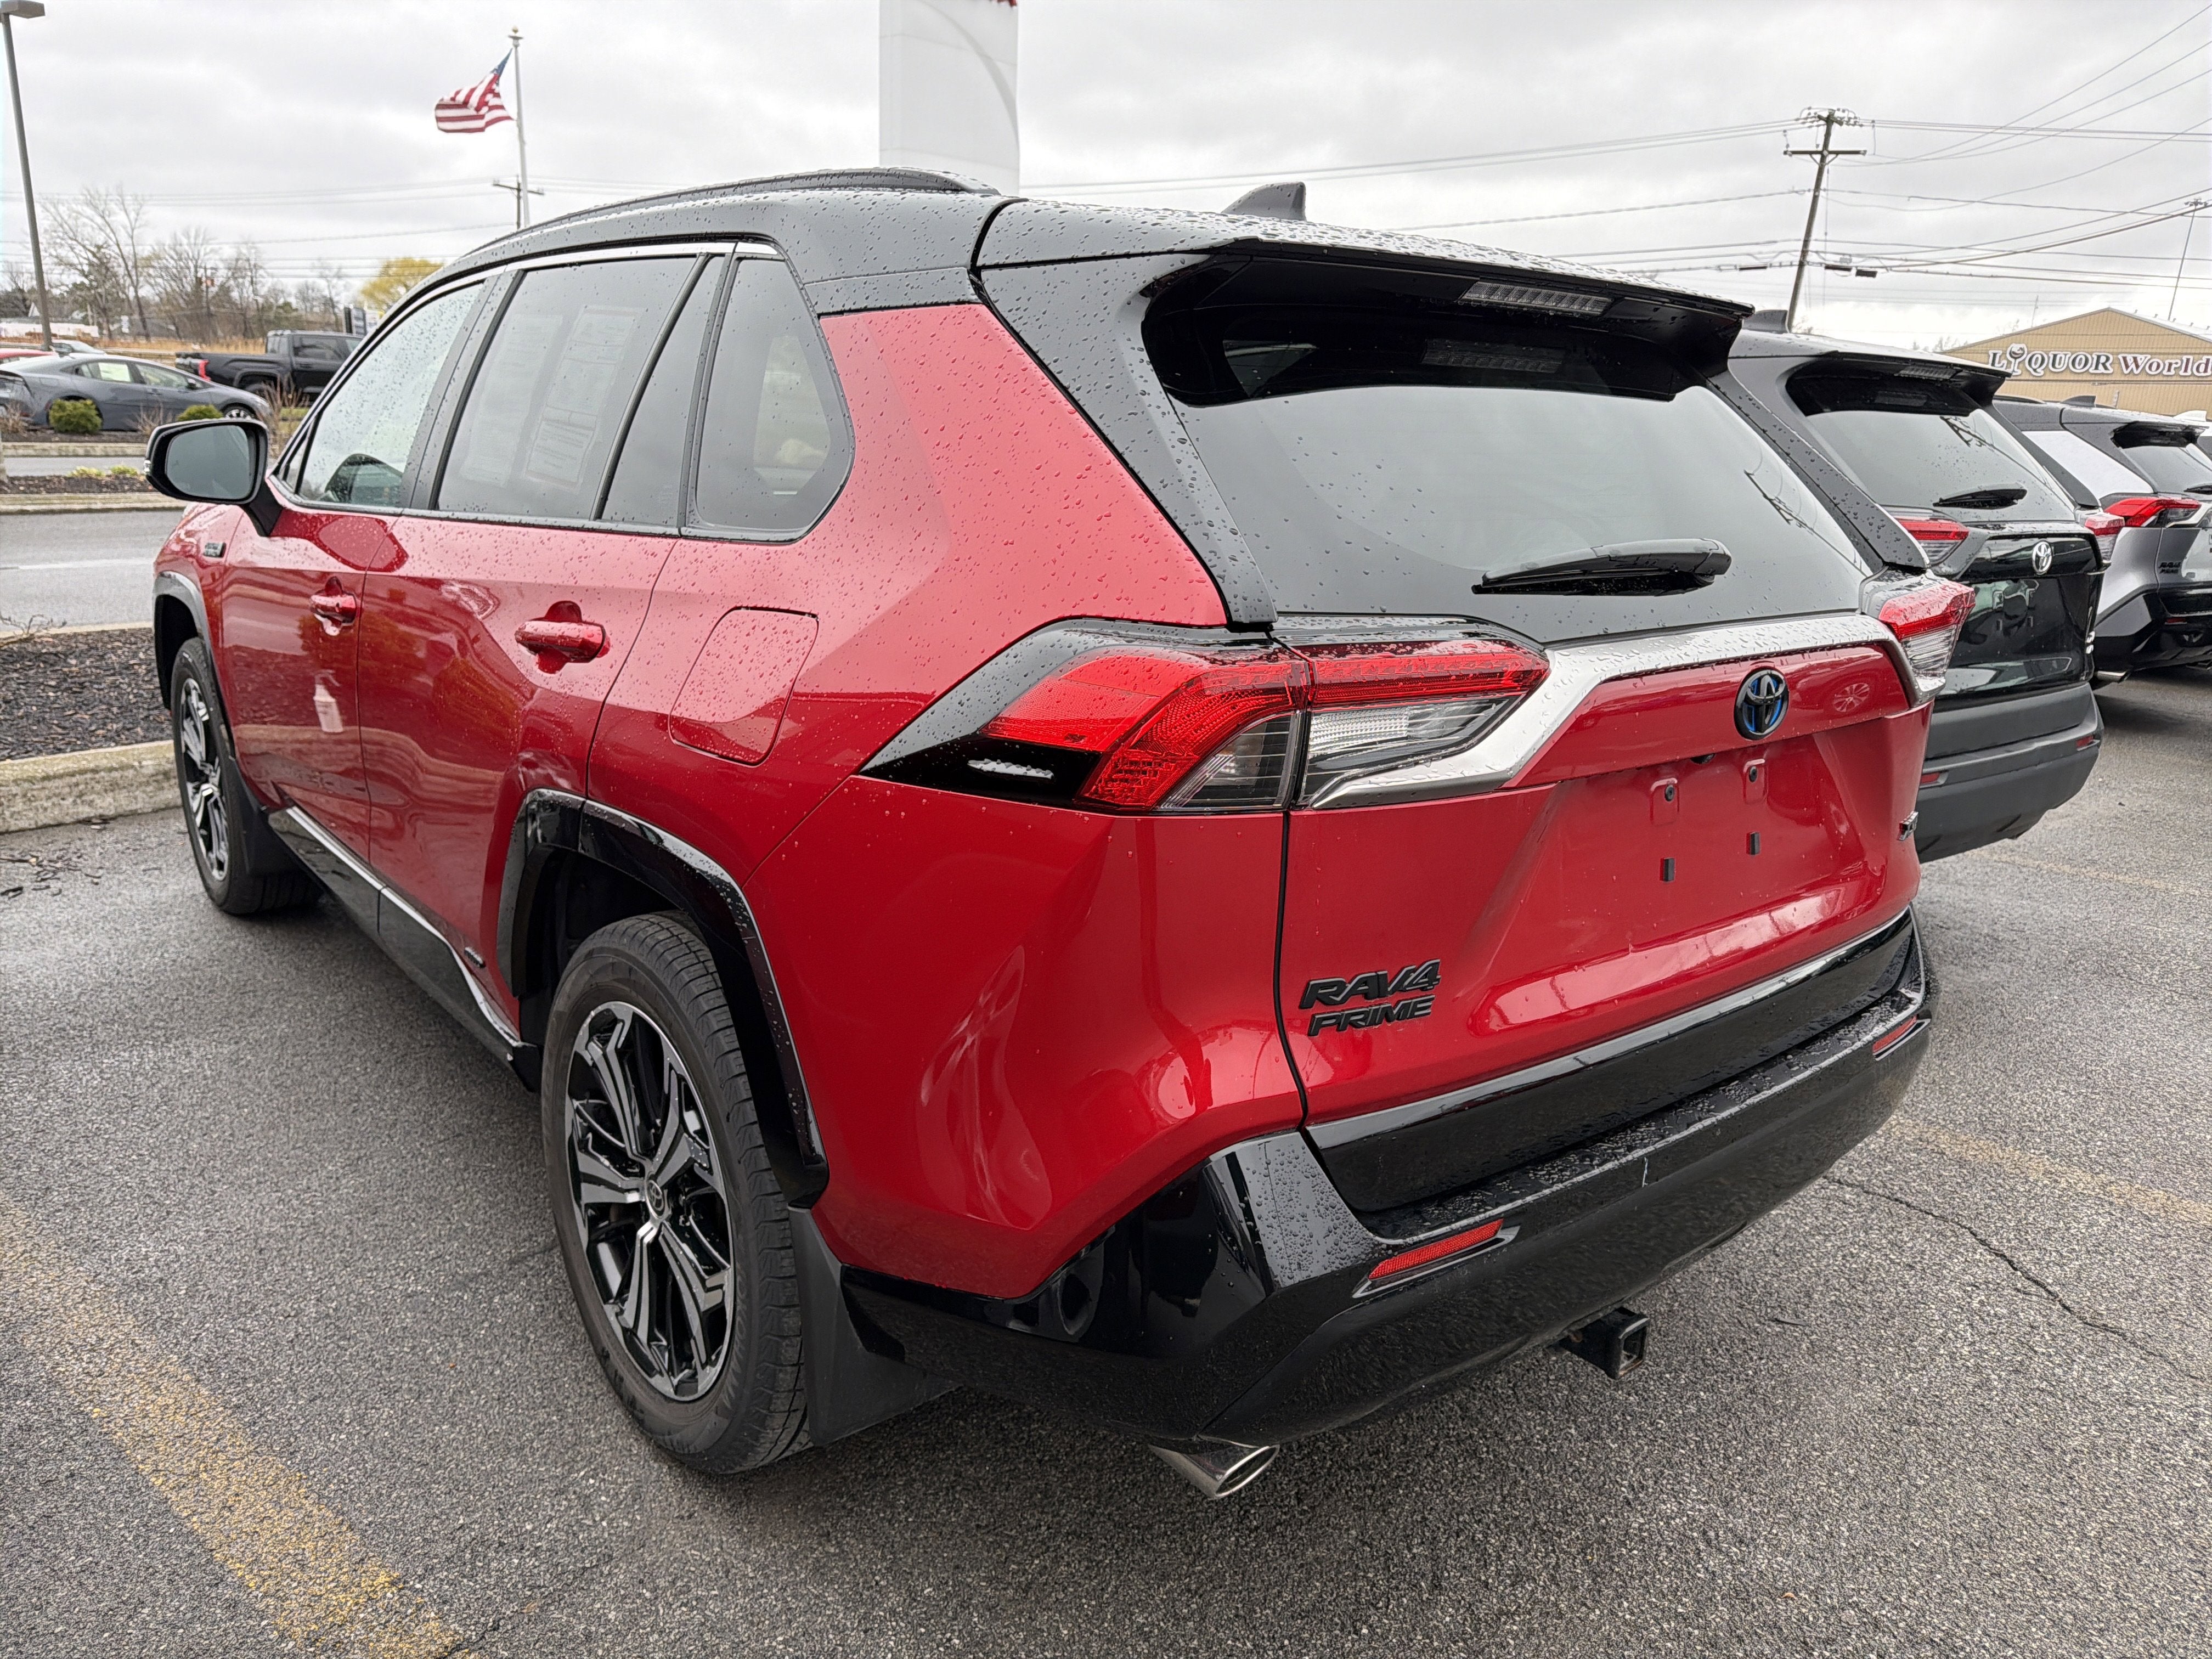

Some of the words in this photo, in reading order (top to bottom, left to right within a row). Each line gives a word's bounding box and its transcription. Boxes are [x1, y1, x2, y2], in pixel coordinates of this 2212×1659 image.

[1989, 343, 2113, 376] LIQUOR
[2119, 354, 2212, 376] World
[1299, 958, 1441, 1009] RAV4
[1307, 994, 1435, 1036] PRIME
